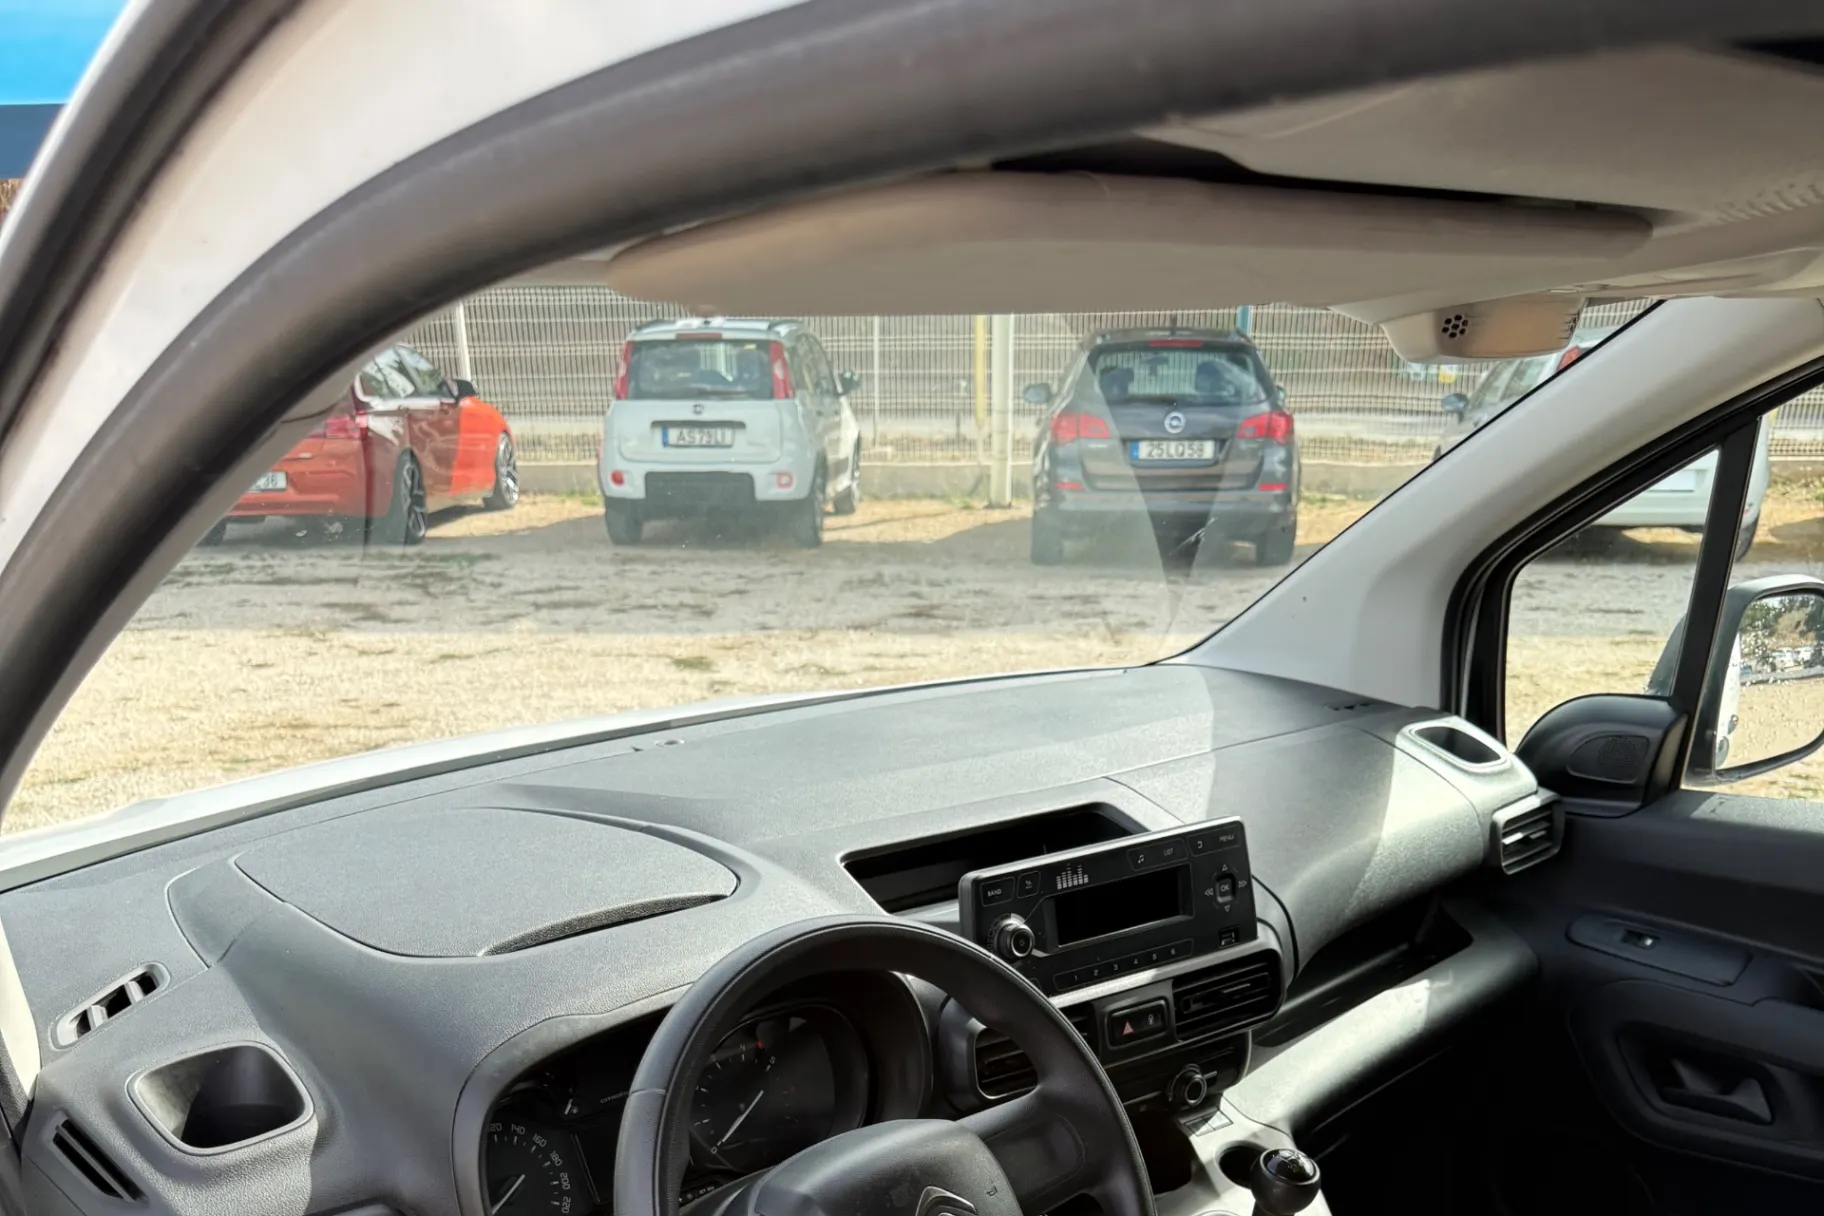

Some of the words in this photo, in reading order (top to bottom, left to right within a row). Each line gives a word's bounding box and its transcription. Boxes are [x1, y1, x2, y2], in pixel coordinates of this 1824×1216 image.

[987, 888, 1003, 897] BAND
[1220, 884, 1230, 892] OK
[511, 1123, 526, 1136] 140
[532, 1133, 548, 1148] 160
[549, 1150, 563, 1167] 180
[559, 1172, 571, 1190] 200
[561, 1196, 572, 1214] 220
